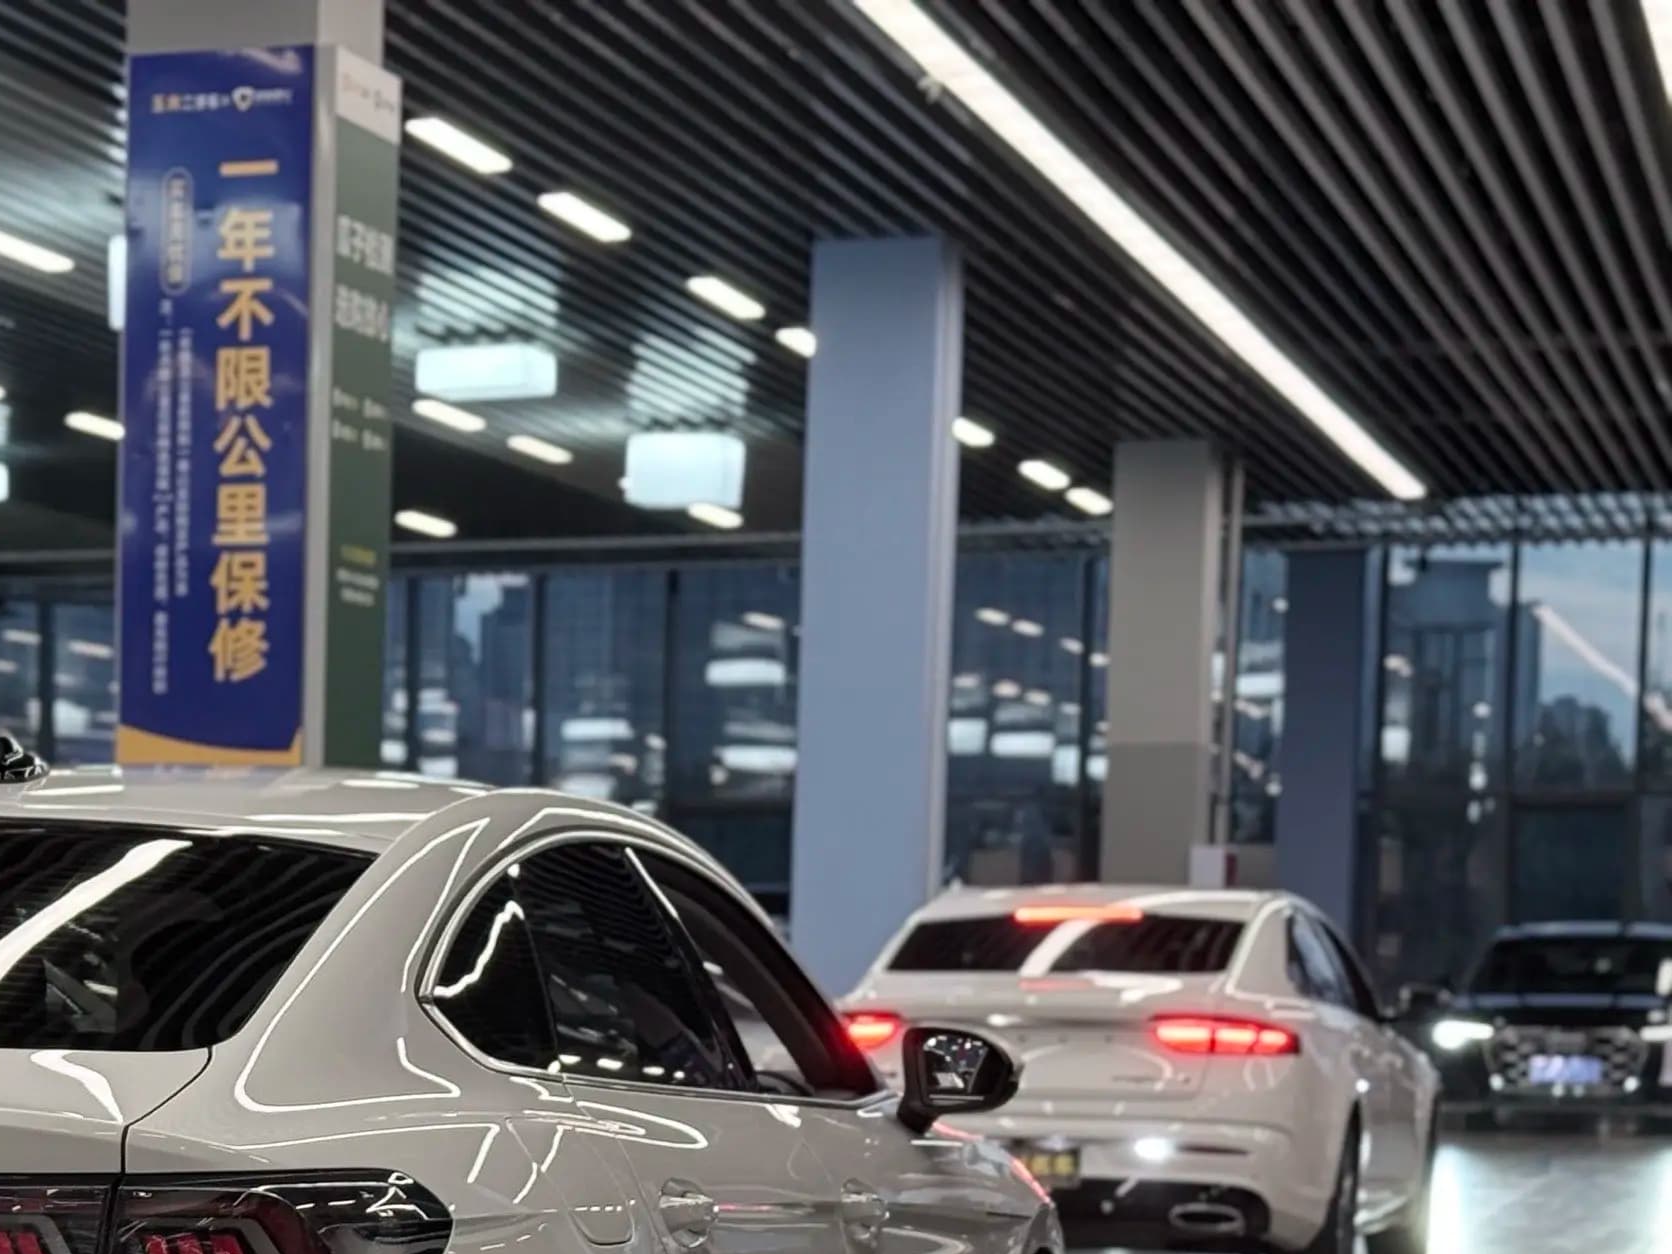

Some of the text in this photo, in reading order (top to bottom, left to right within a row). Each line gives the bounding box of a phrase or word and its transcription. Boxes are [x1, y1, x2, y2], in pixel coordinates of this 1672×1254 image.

[208, 160, 279, 683] 一年不限公里保修
